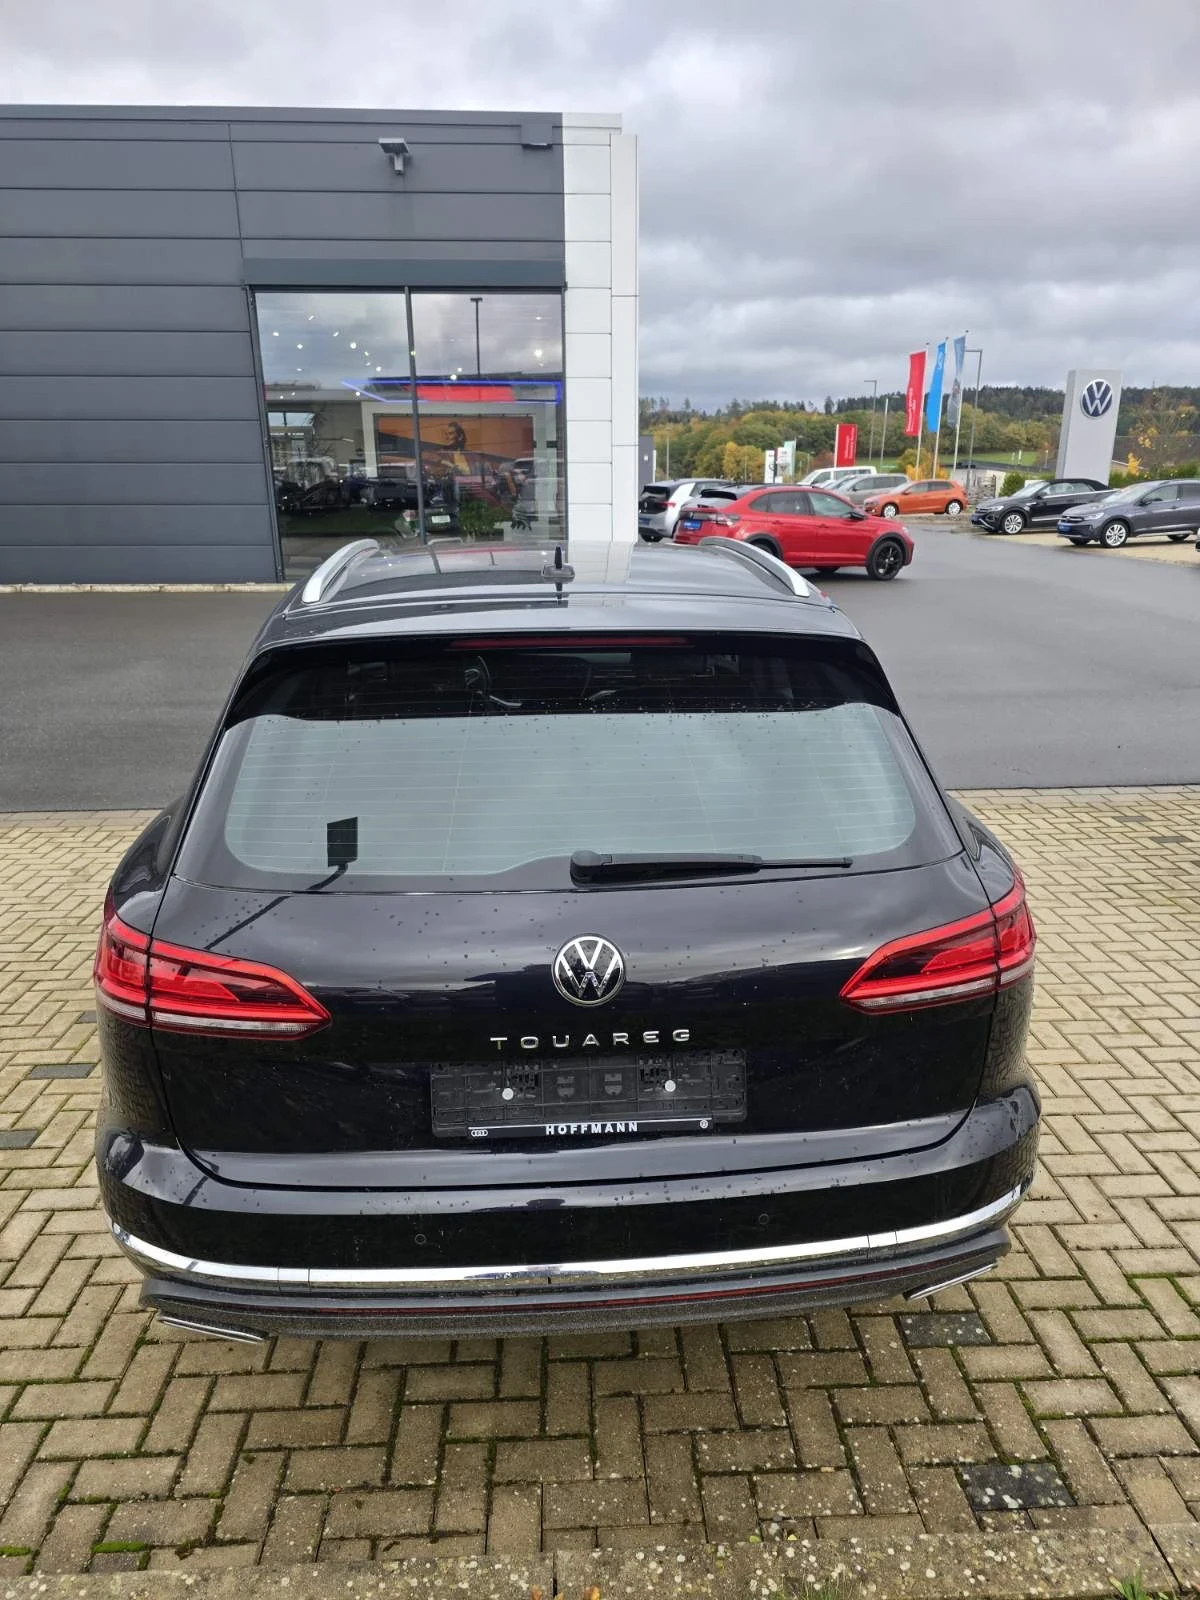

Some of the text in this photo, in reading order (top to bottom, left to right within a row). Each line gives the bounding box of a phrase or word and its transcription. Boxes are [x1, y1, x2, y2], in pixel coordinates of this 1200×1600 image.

[1081, 379, 1112, 417] VW
[554, 935, 624, 1004] VW
[490, 1029, 690, 1050] TOUAREG
[545, 1121, 638, 1136] HOFFMANN
